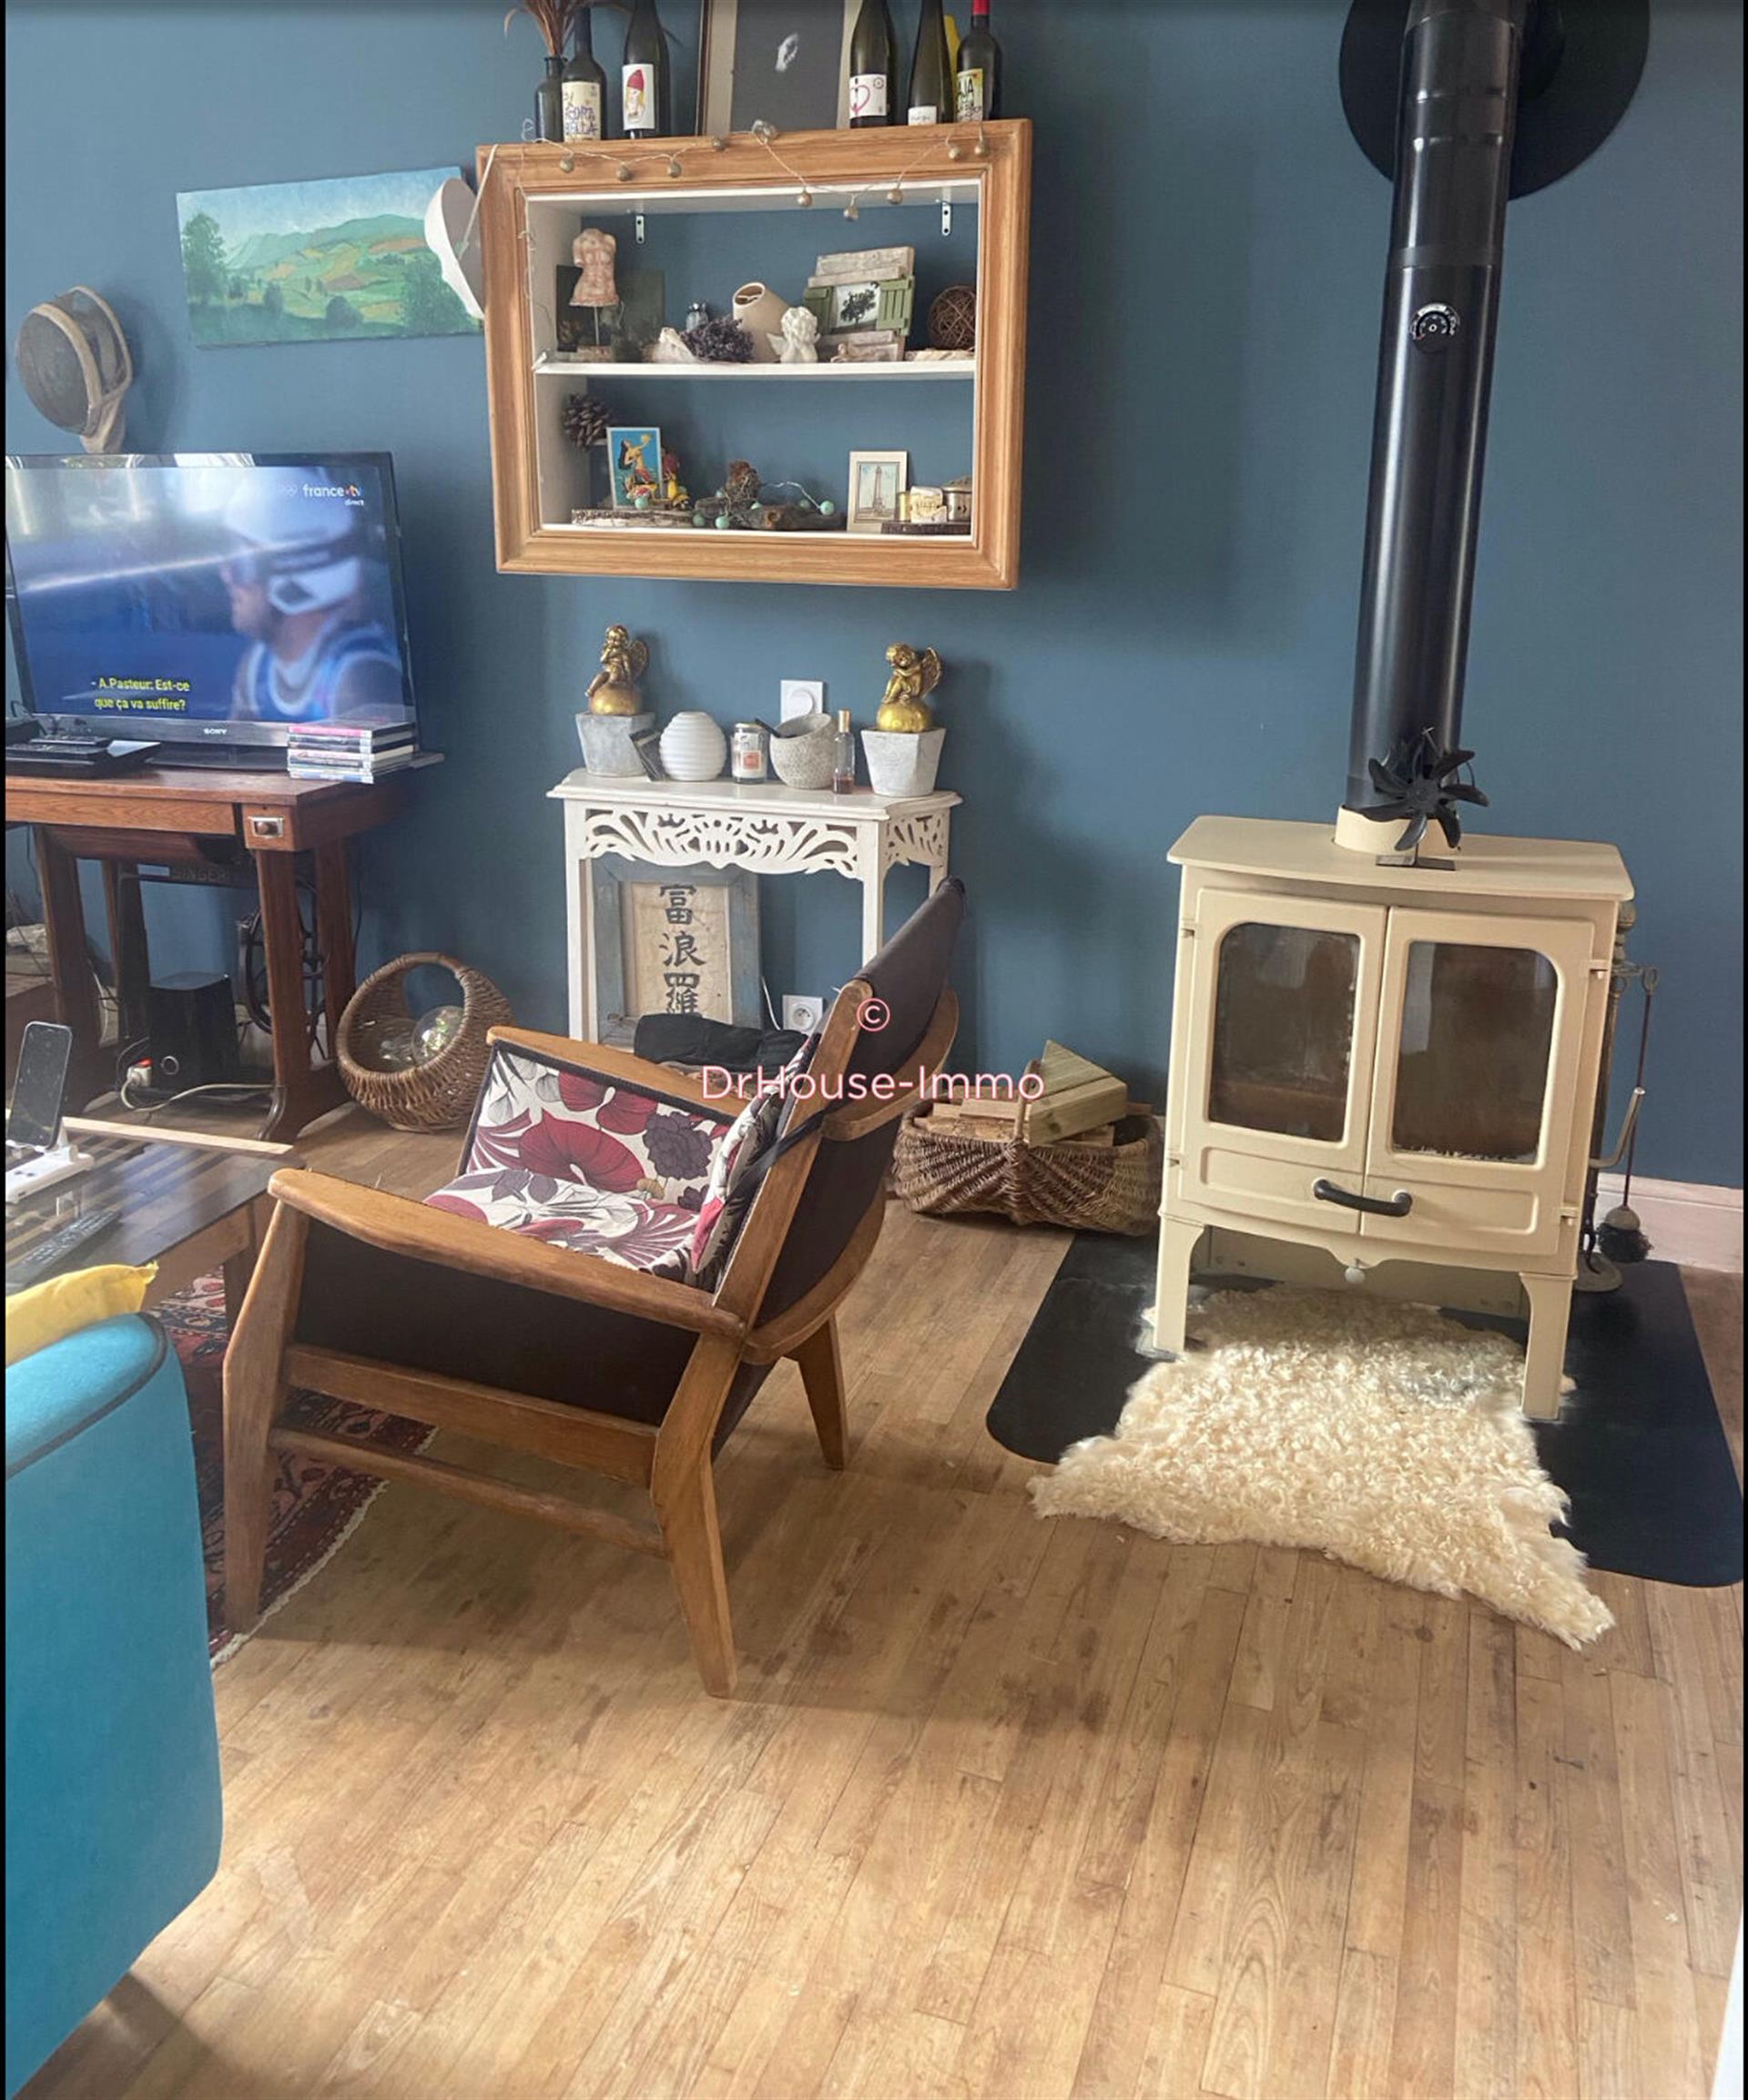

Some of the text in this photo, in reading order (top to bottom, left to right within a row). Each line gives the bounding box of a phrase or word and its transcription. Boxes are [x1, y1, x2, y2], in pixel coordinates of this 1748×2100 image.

[155, 678, 190, 691] Est-ce
[94, 696, 186, 711] que ça va suffire?
